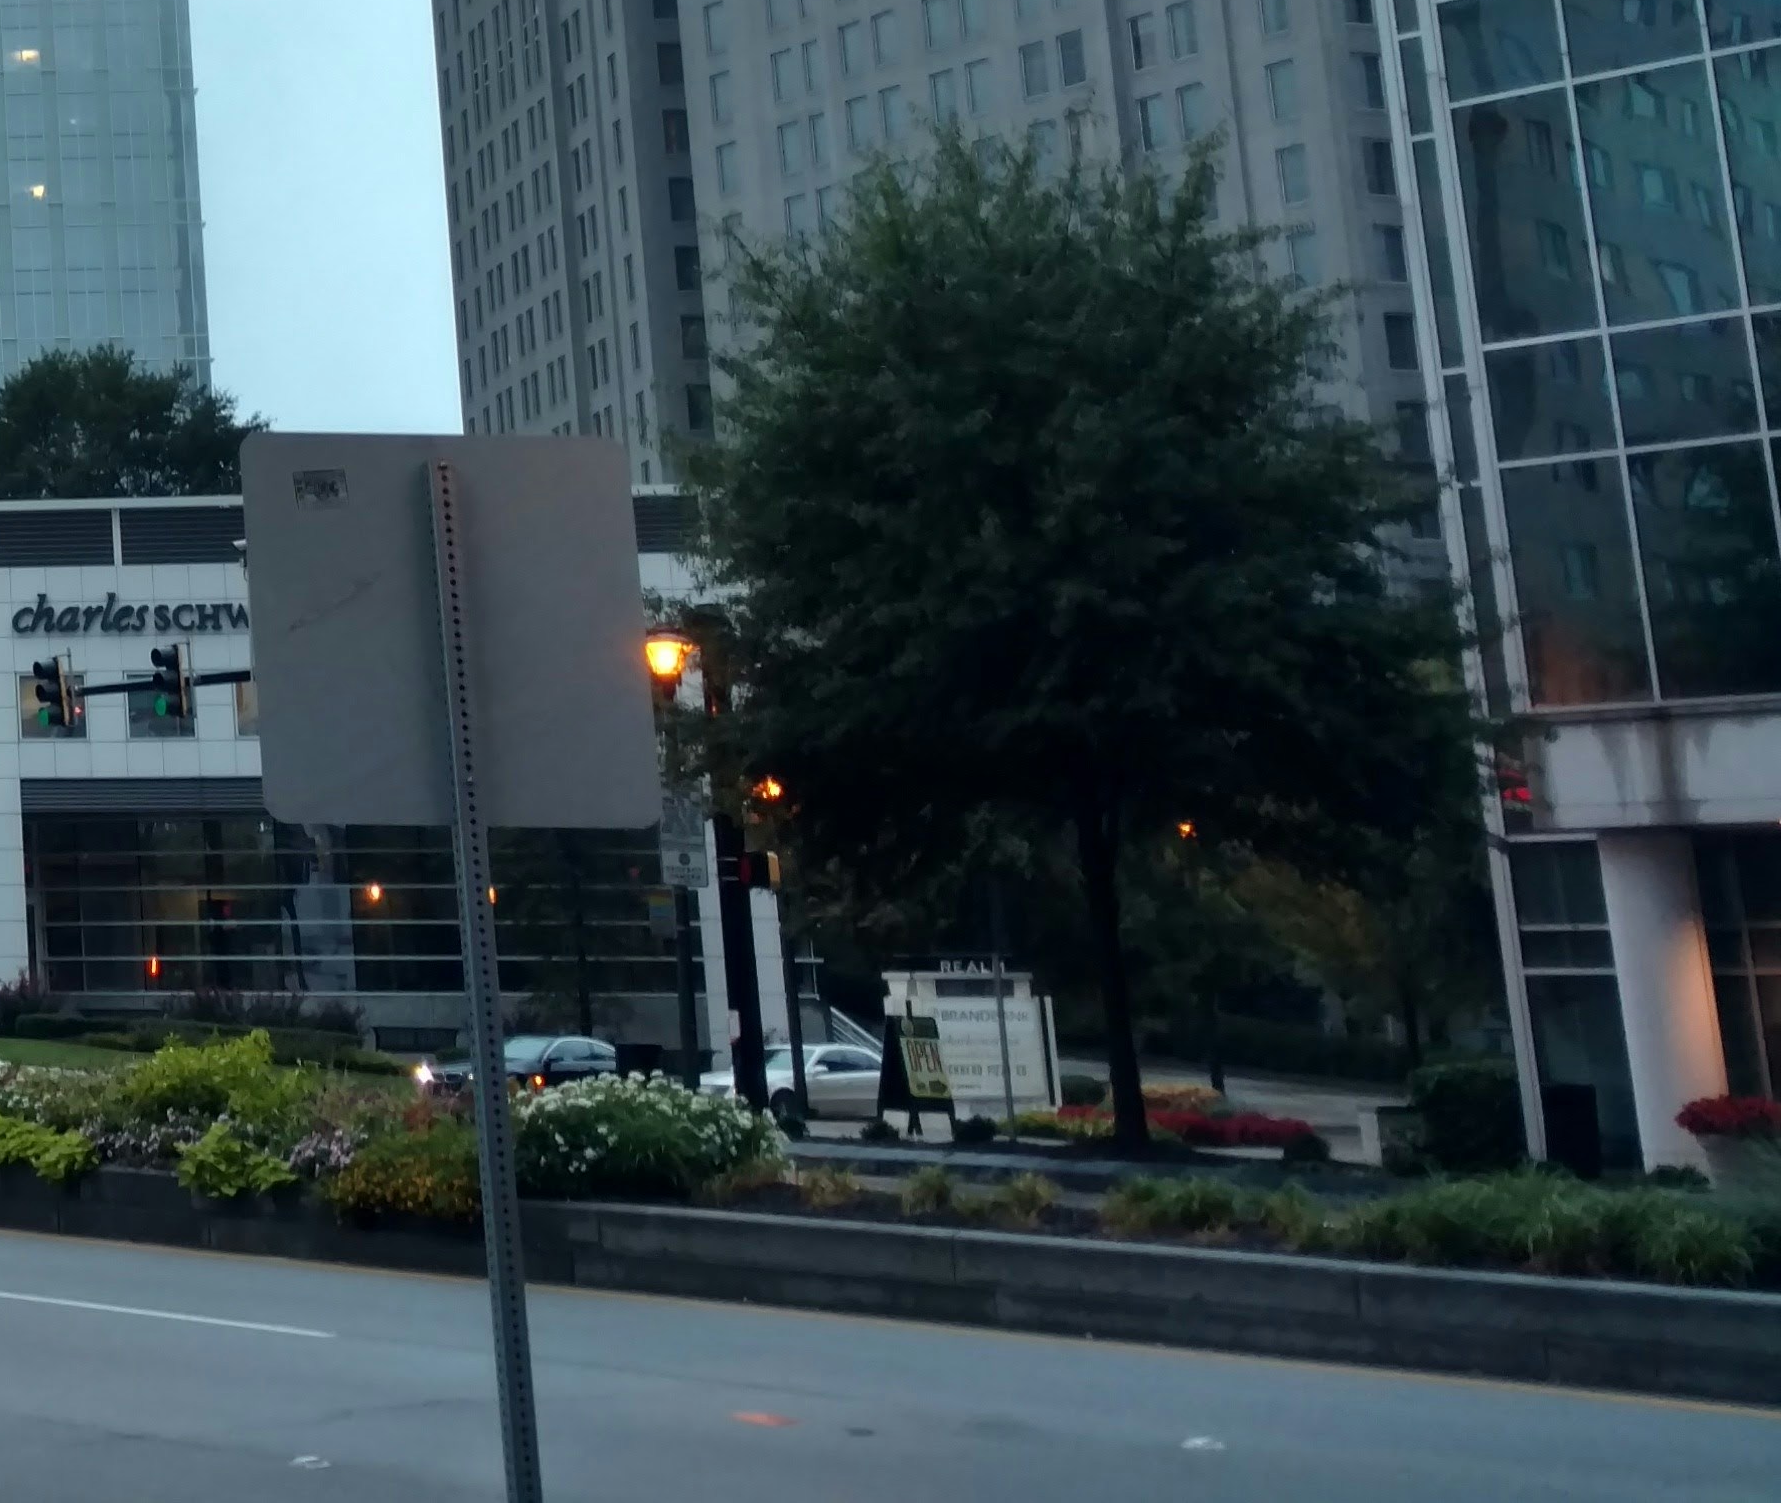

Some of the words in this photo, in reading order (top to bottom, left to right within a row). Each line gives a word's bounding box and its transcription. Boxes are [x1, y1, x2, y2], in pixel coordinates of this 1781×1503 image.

[12, 592, 149, 634] charles
[154, 603, 248, 631] SCHW
[906, 1040, 943, 1072] OPEN
